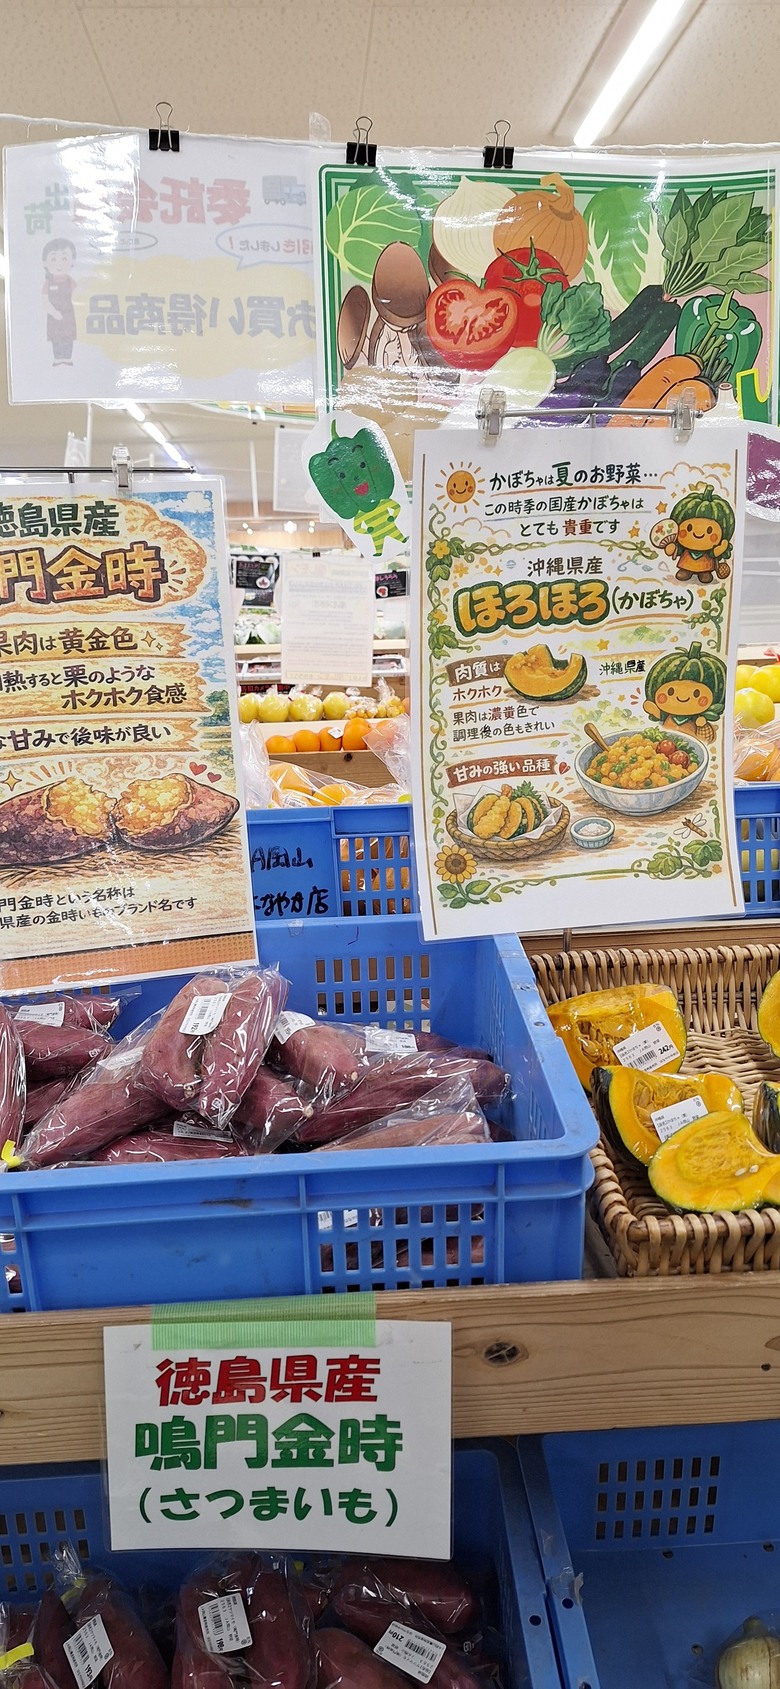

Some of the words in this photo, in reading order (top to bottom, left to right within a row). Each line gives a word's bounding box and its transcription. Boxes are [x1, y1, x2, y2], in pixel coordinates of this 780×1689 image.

[484, 496, 644, 516] この時季の国産かぼちゃは
[527, 556, 603, 577] 沖縄県産
[454, 660, 502, 683] 肉質は
[599, 659, 646, 676] 沖縄県産
[61, 683, 187, 710] ホクホク食感
[452, 685, 502, 702] ホクホク
[453, 720, 555, 742] 調理後の色もきれい
[453, 759, 551, 782] 甘みの強い品種
[155, 1354, 381, 1407] 徳島県産
[135, 1412, 403, 1472] 鳴門金時
[139, 1486, 398, 1527] （さつまいも）
